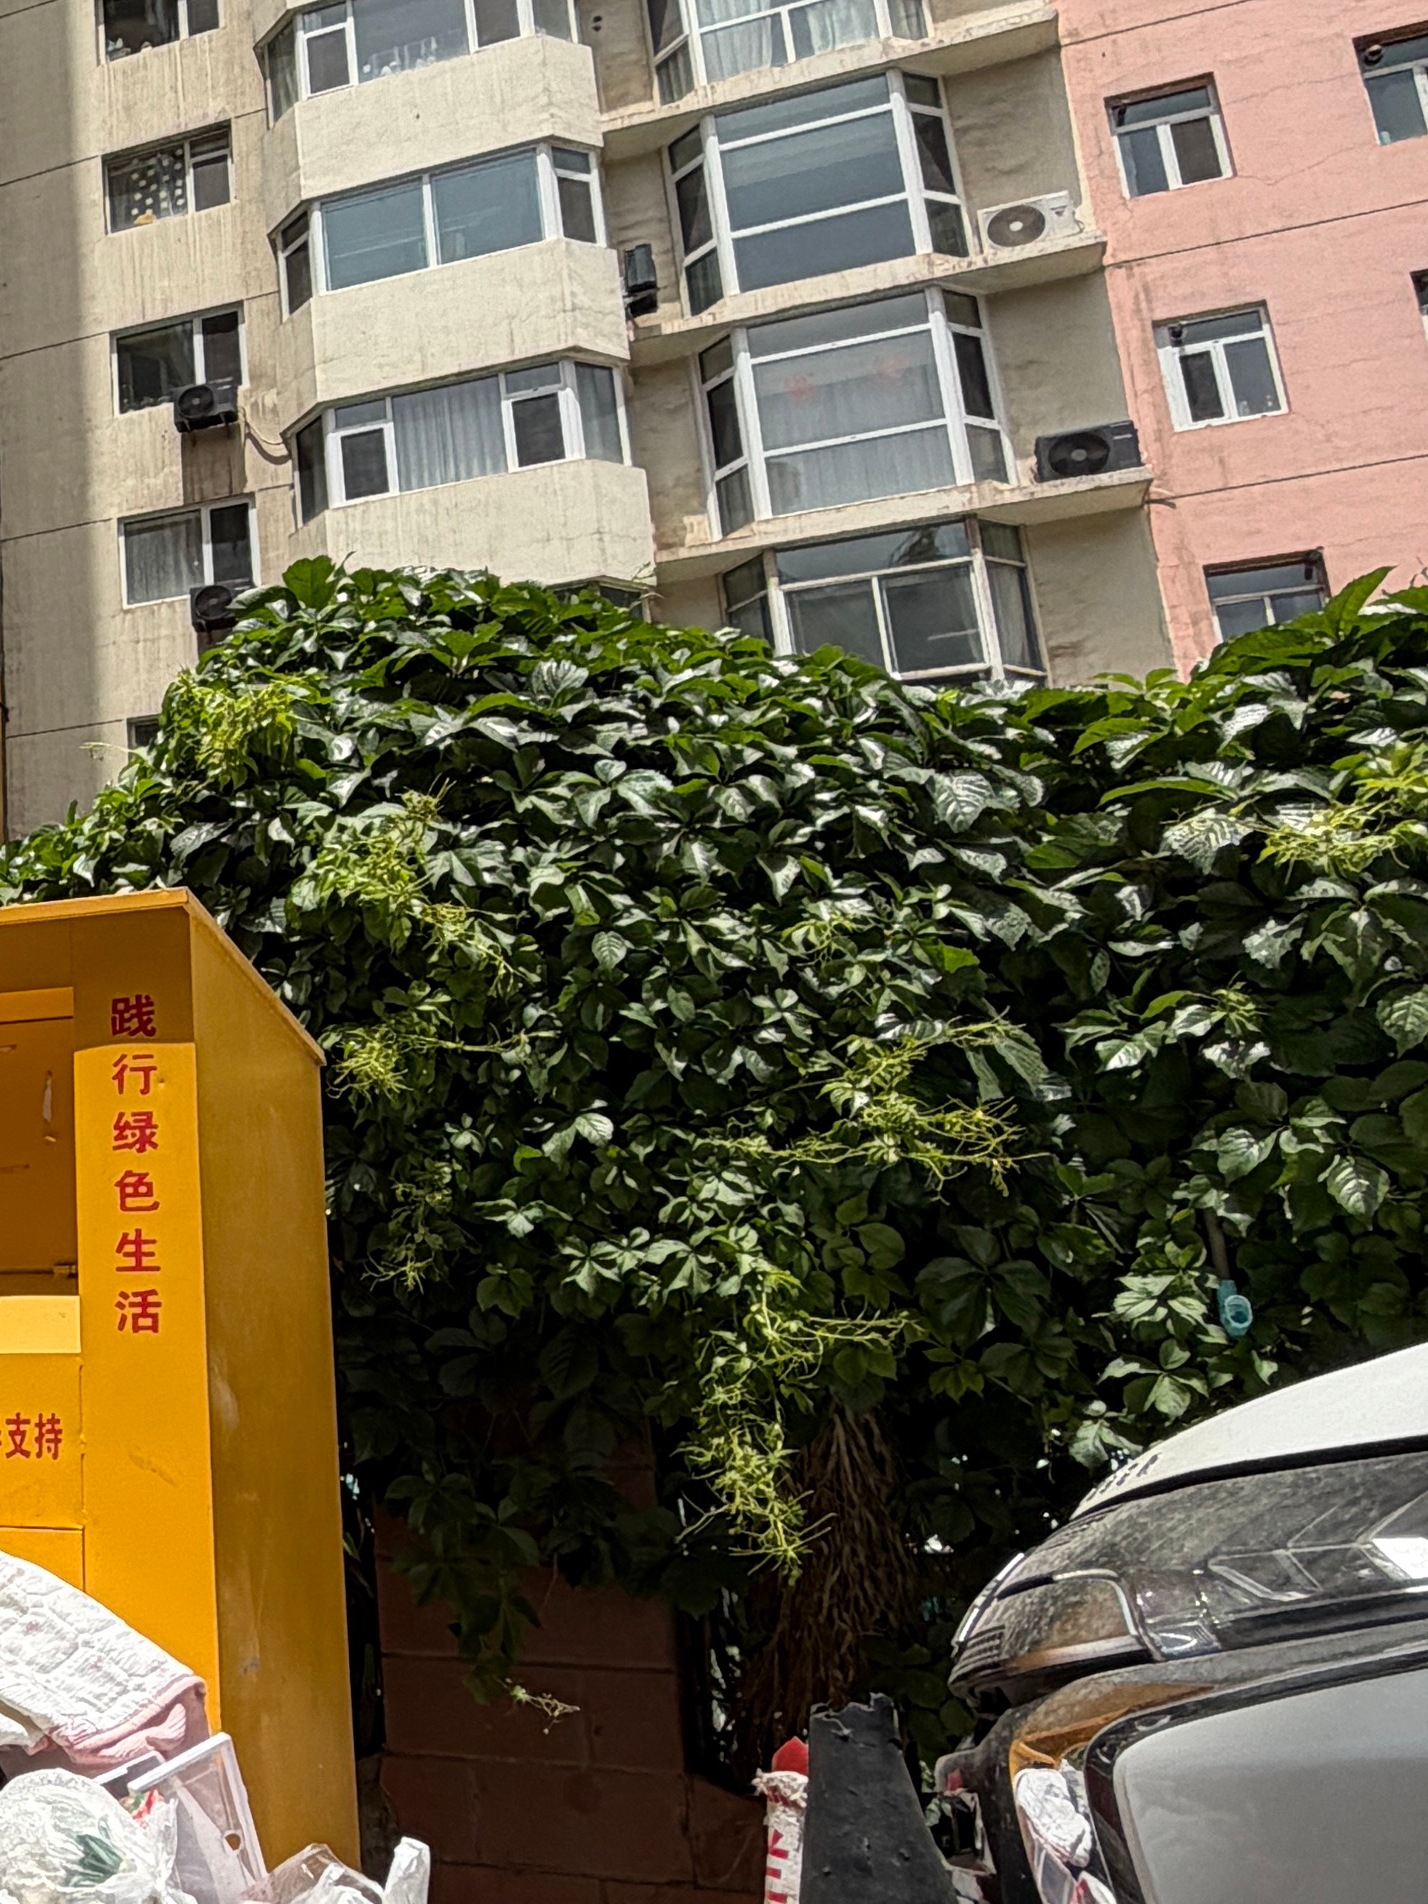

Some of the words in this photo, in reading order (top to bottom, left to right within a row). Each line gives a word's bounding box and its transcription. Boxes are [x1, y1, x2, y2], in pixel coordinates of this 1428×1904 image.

[110, 994, 163, 1334] 践行绿色生活
